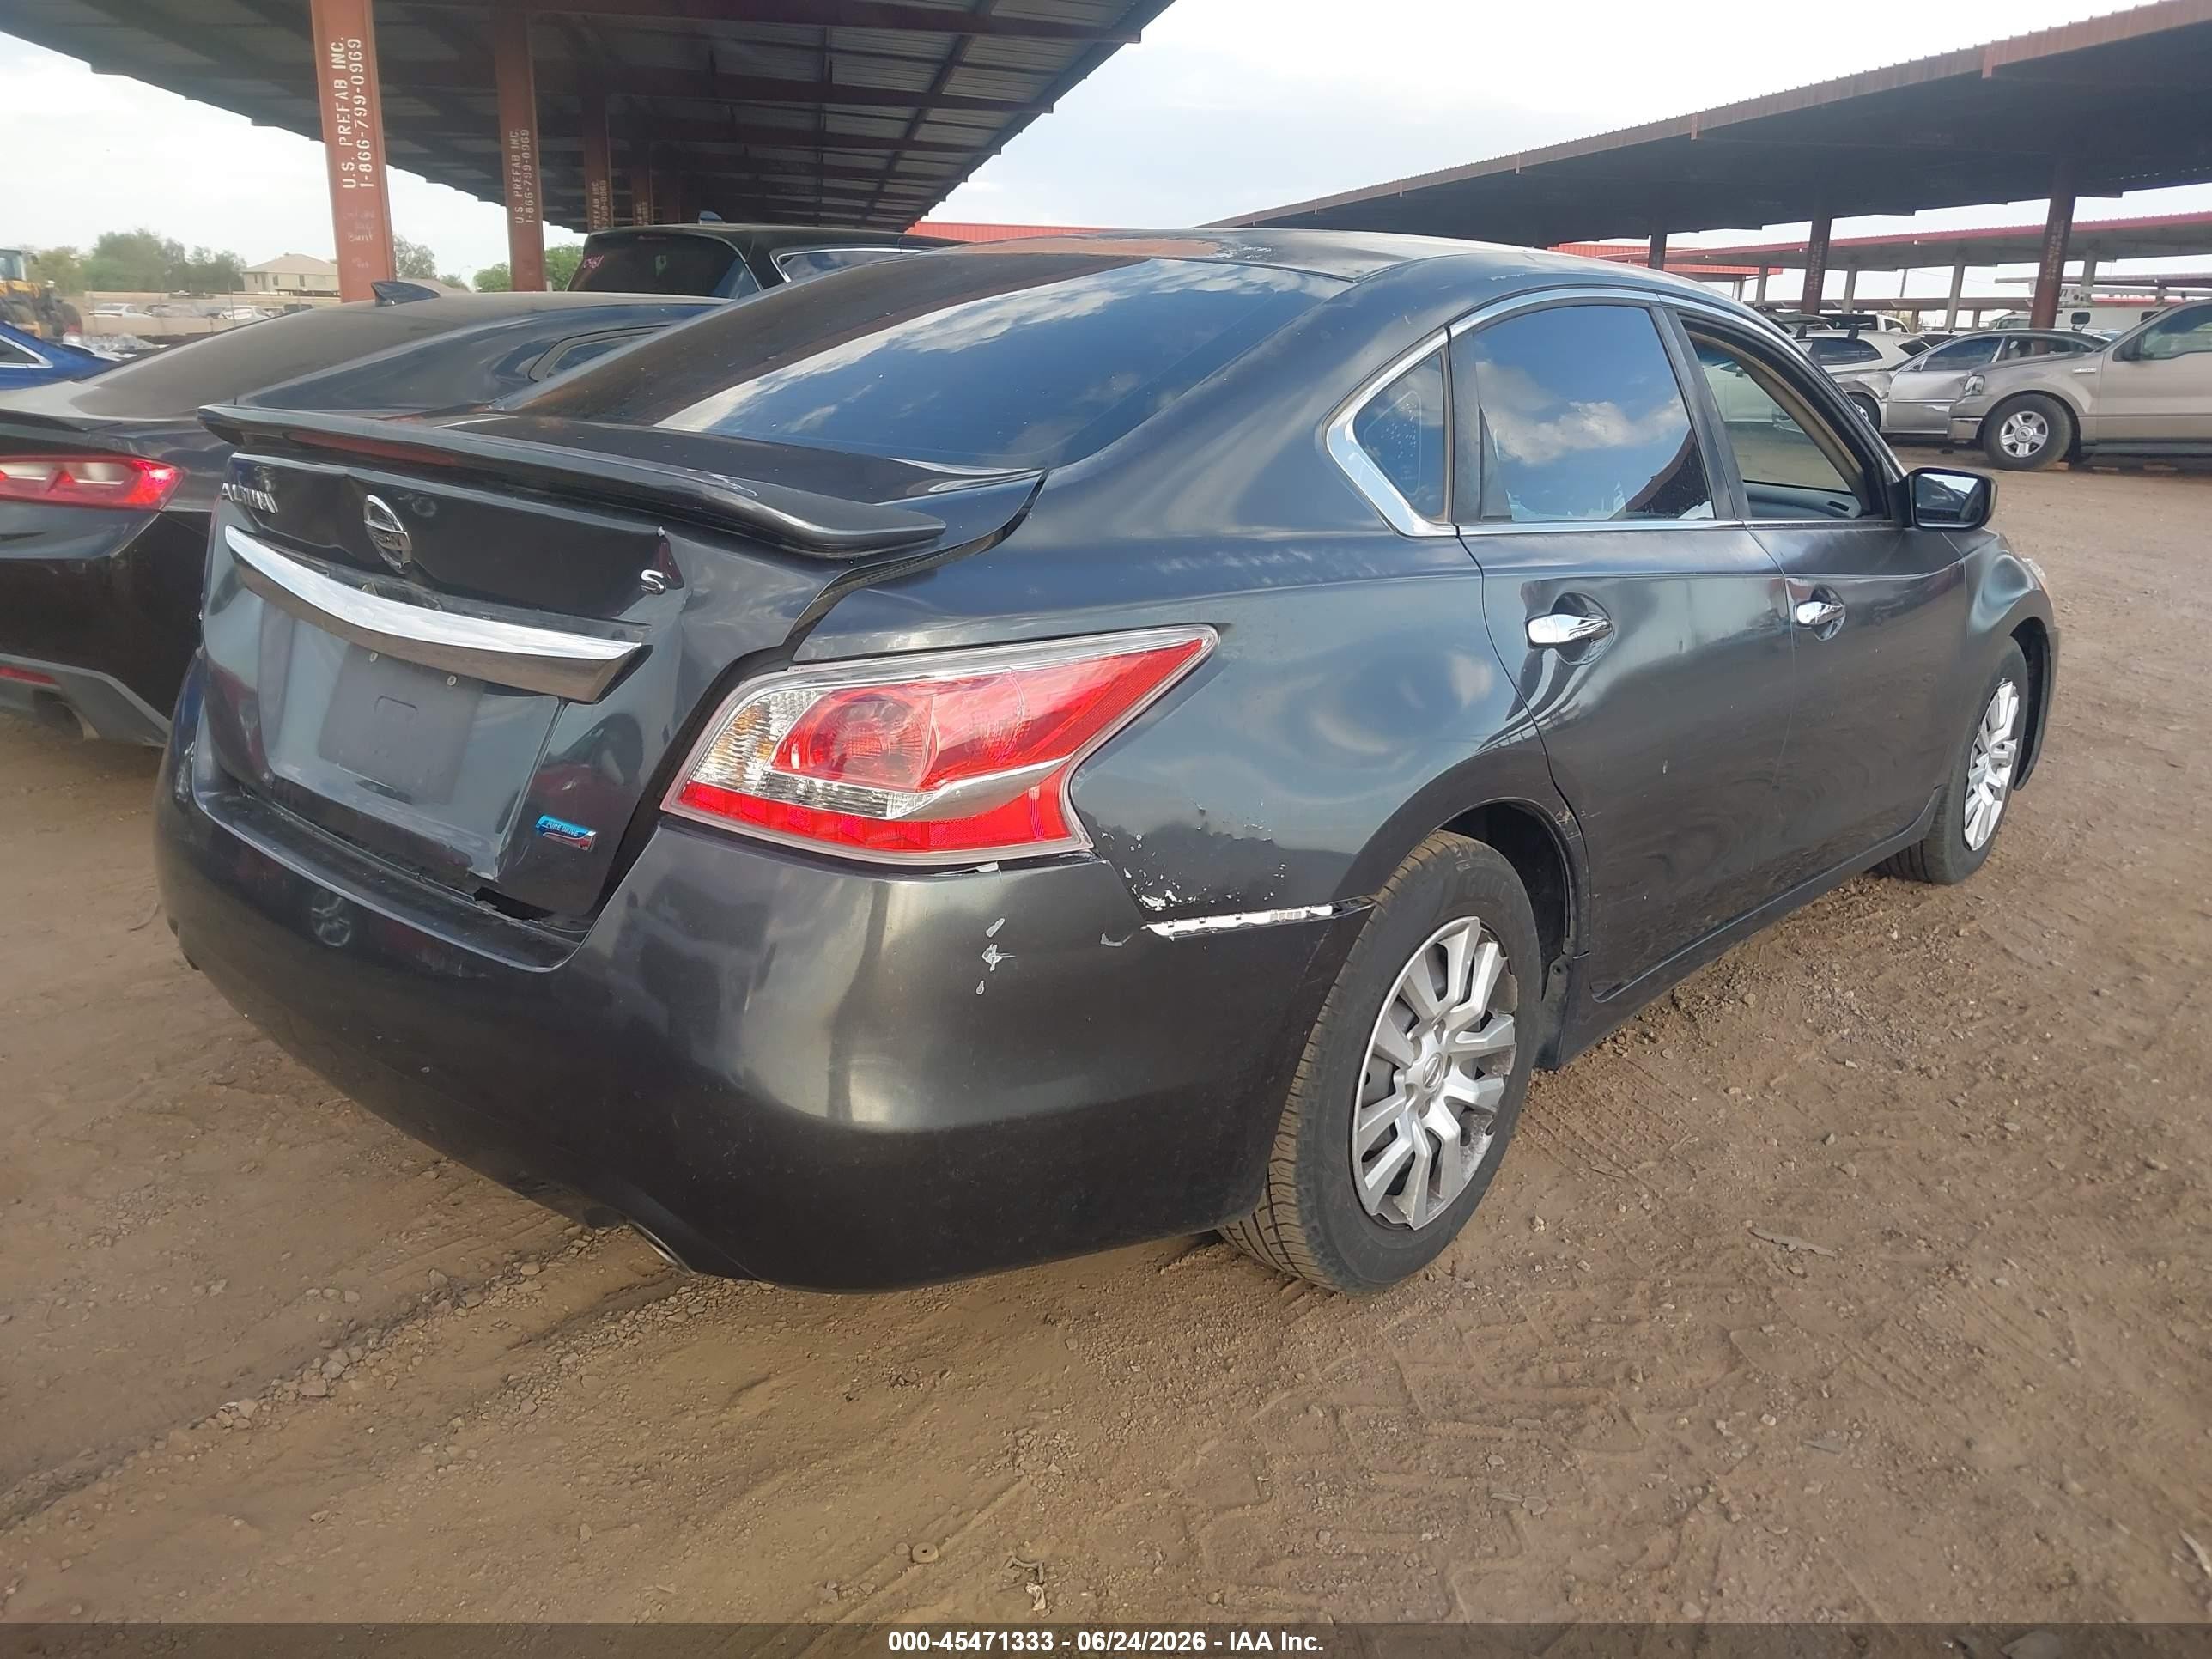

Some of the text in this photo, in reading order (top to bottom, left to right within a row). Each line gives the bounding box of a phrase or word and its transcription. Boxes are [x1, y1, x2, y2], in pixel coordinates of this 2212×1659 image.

[330, 37, 357, 189] U.S. PREFAB INC.
[347, 38, 375, 188] 1-866-799-0969
[511, 155, 523, 198] PREFAB
[640, 568, 665, 594] S
